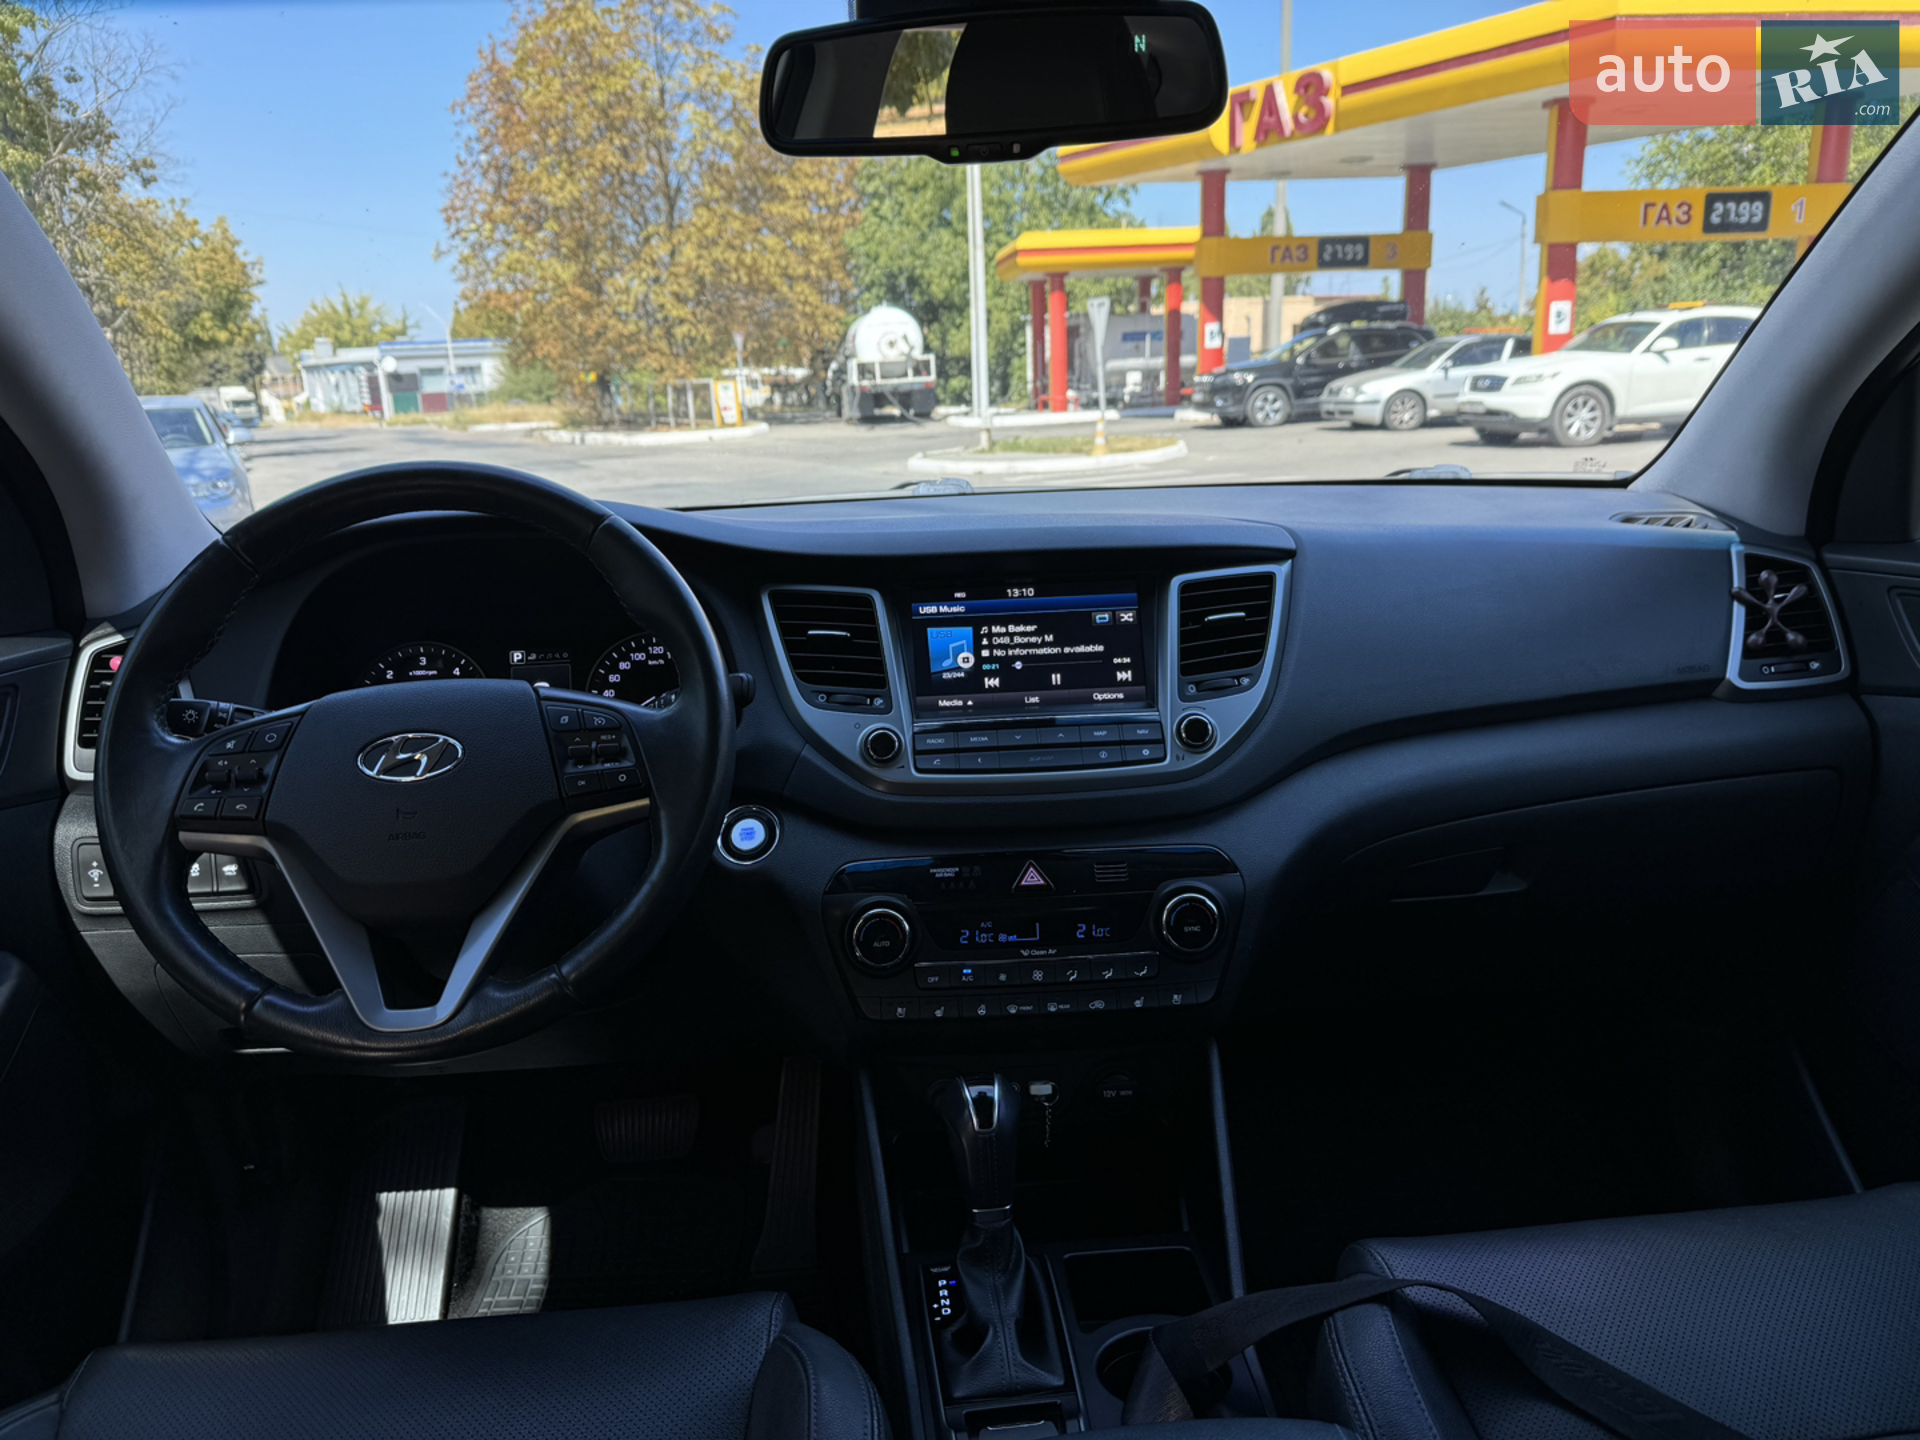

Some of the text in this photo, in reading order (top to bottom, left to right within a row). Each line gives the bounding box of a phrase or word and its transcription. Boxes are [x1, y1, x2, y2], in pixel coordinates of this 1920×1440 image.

[1133, 34, 1147, 52] N
[1229, 71, 1333, 149] ГАЗ
[1640, 196, 1807, 227] ГАЗ 27.99 1
[1269, 244, 1310, 264] ГАЗ
[1006, 588, 1035, 598] 13:10
[919, 605, 966, 614] USB Music
[991, 624, 1038, 634] Ma Baker
[930, 630, 953, 639] USB
[1044, 634, 1053, 642] M
[648, 646, 664, 655] 120
[993, 644, 1104, 657] No information available
[419, 656, 427, 666] 3
[513, 652, 523, 663] P
[629, 652, 646, 661] 100
[618, 661, 631, 670] 80
[648, 658, 665, 666] km/h
[386, 669, 394, 680] 2
[452, 667, 460, 677] 4
[608, 673, 621, 683] 60
[602, 689, 616, 698] 40
[1093, 692, 1124, 701] Options
[938, 699, 963, 708] Media
[1025, 695, 1040, 704] List
[388, 831, 427, 841] AIRBAG
[1183, 925, 1202, 933] SYNC
[872, 940, 891, 948] AUTO
[1030, 948, 1048, 956] Clean
[927, 975, 940, 983] OFF
[961, 974, 974, 982] A/C
[937, 1279, 948, 1288] P
[938, 1288, 949, 1298] R
[940, 1297, 951, 1307] N
[941, 1307, 952, 1316] D
